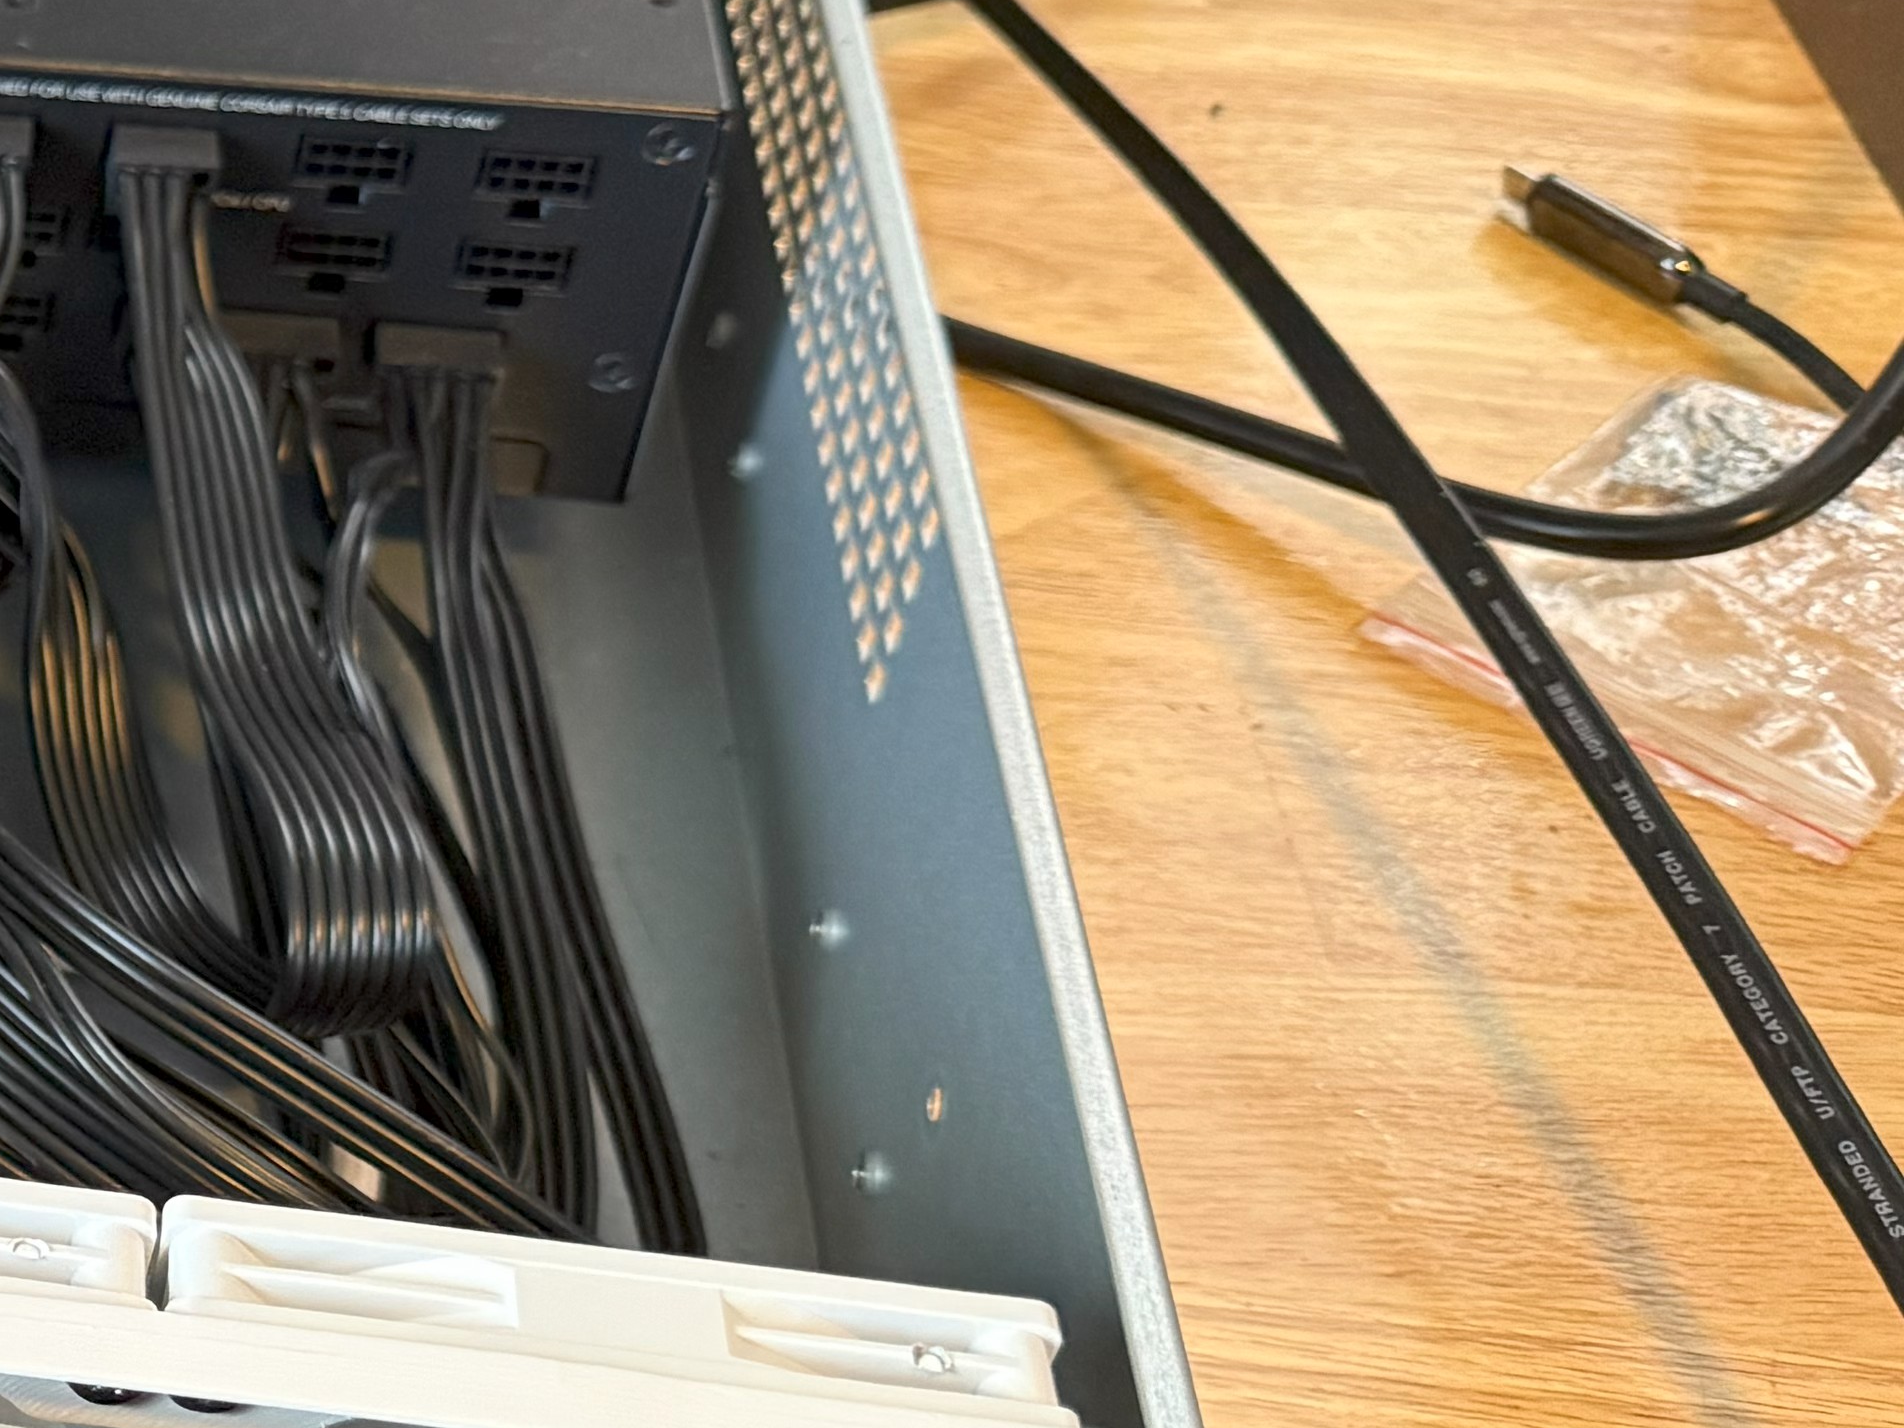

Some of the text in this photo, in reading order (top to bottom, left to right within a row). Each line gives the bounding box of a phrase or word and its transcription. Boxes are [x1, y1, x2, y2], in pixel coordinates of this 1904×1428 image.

[1611, 778, 1657, 834] CABLE
[1656, 849, 1703, 906] PATCH
[1720, 953, 1789, 1045] CATEGORY
[1790, 1065, 1835, 1121] U/FTP
[1837, 1139, 1904, 1239] STRANDED
